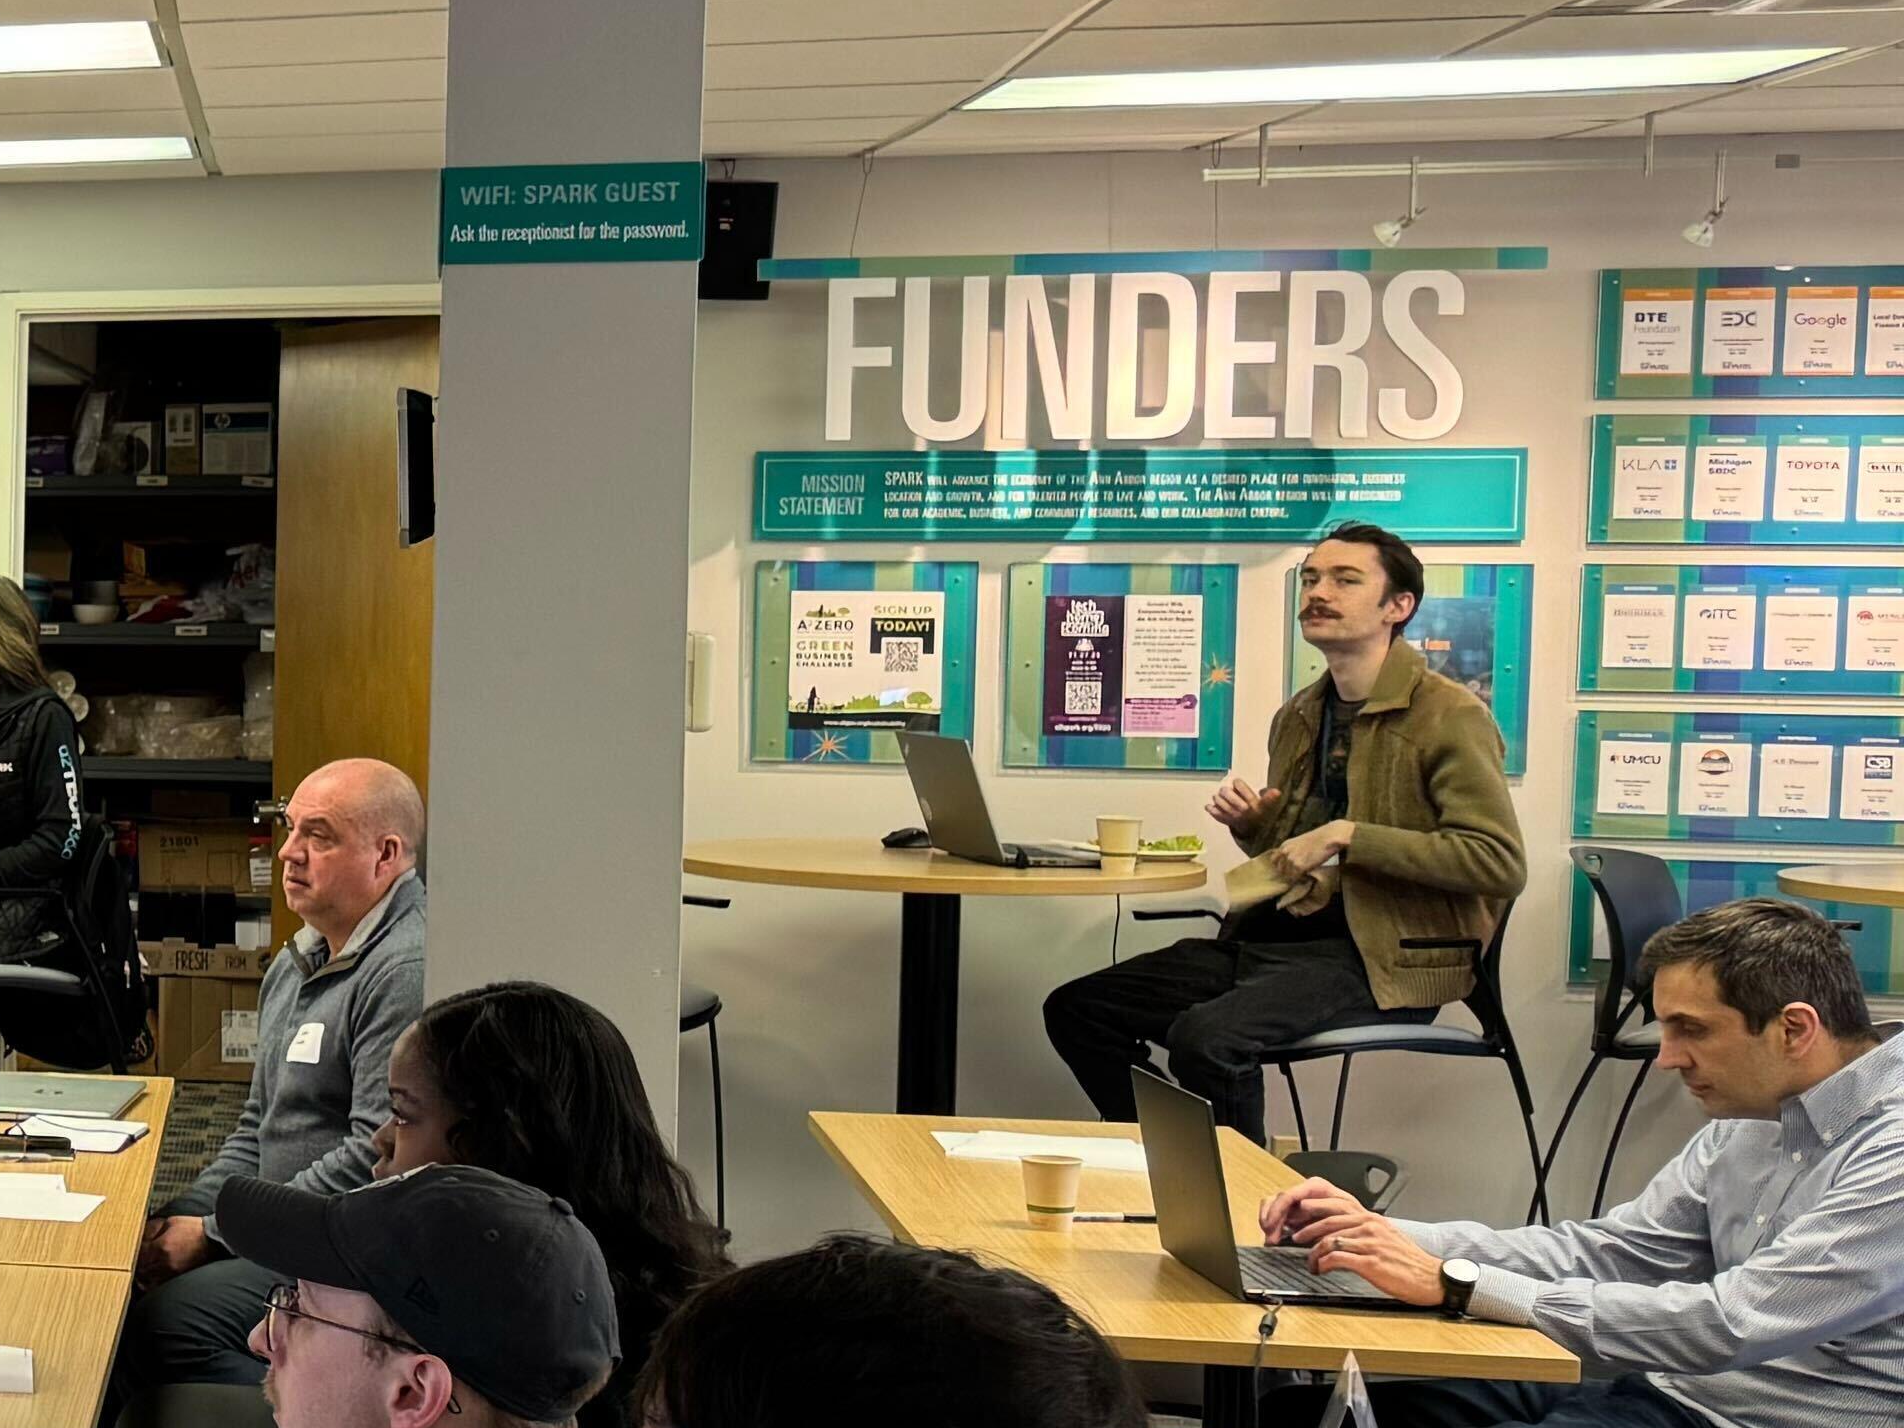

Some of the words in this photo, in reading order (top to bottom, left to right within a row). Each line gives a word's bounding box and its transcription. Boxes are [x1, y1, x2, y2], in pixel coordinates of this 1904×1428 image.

[460, 186, 516, 206] WIFI:
[524, 183, 597, 204] SPARK
[605, 181, 680, 202] GUEST
[450, 225, 475, 242] Ask
[478, 224, 498, 241] the
[502, 222, 575, 244] receptionist
[578, 222, 596, 239] for
[599, 222, 620, 238] the
[623, 221, 689, 242] password.
[1635, 312, 1667, 323] DTE
[1794, 313, 1847, 328] Google
[825, 269, 1466, 442] FUNDERS
[1622, 459, 1661, 470] KLA
[1787, 461, 1840, 470] TOYOTA
[802, 474, 864, 493] MISSION
[885, 471, 923, 486] SPARK
[779, 496, 864, 516] STATEMENT
[874, 605, 907, 615] SIGN
[913, 606, 932, 615] UP
[875, 620, 930, 633] TODAY!
[797, 641, 854, 651] GREEN
[796, 653, 853, 661] BUSINESS
[1622, 755, 1661, 765] UMCU
[176, 950, 208, 971] FRESH
[225, 957, 246, 971] FROM
